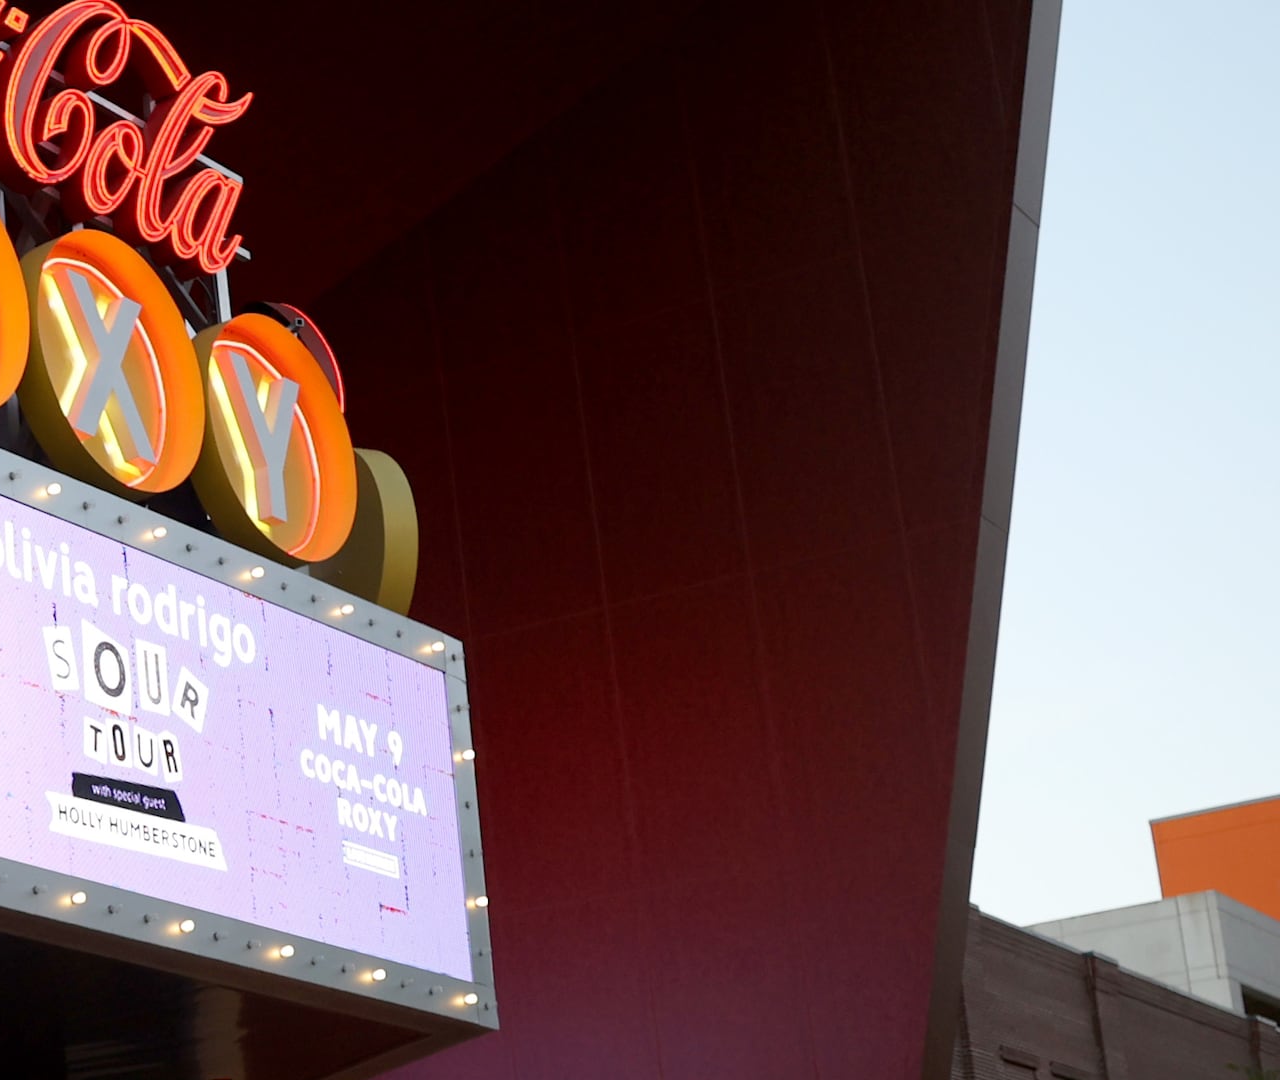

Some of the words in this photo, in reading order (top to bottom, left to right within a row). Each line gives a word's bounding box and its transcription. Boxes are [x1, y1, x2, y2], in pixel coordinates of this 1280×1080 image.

[111, 568, 257, 669] rodrigo
[51, 639, 200, 720] SOUR
[89, 723, 179, 774] TOUR
[317, 702, 378, 758] MAY
[386, 730, 404, 768] 9
[91, 783, 112, 797] with
[112, 786, 142, 804] special
[142, 793, 167, 811] guest
[300, 748, 428, 817] COCA-COLA
[58, 804, 104, 830] HOLLY
[109, 818, 217, 858] HUMBERSTONE
[336, 796, 398, 842] ROXY
